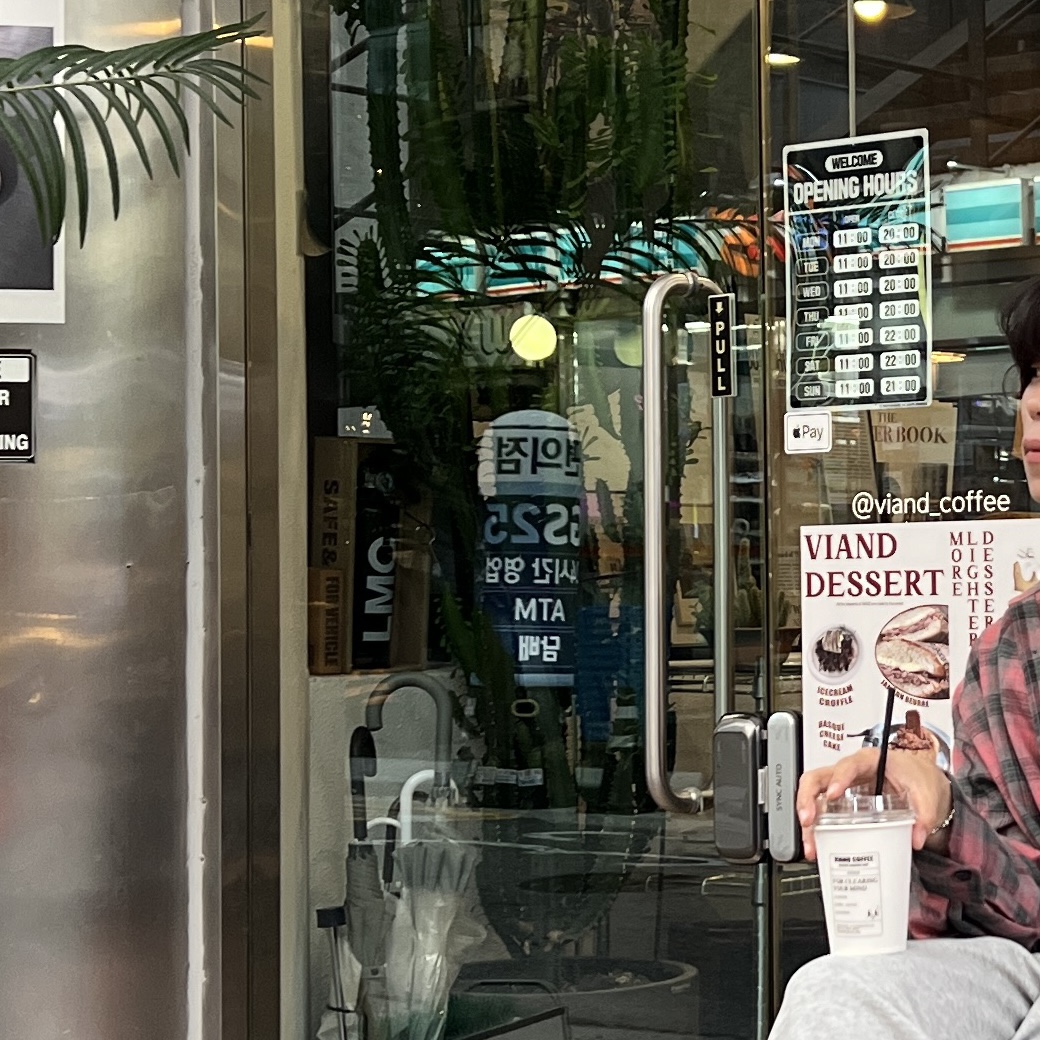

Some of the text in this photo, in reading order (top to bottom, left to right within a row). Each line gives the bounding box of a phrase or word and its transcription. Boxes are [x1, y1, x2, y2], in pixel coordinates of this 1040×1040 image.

[831, 152, 878, 170] WELCOME
[793, 170, 919, 205] OPENING HOURS
[804, 261, 819, 273] TUE
[802, 286, 821, 298] WED
[804, 311, 820, 323] THU
[715, 321, 726, 391] PULL
[804, 360, 820, 372] SAT
[803, 385, 821, 397] SUN
[877, 411, 897, 424] THE
[802, 424, 824, 442] Pay
[873, 425, 948, 444] ER BOOK
[851, 489, 1011, 520] @viand_coffee
[804, 532, 898, 560] VIAND
[950, 531, 963, 597] MORE
[805, 569, 945, 598] DESSERT
[982, 531, 995, 625] DESSER
[967, 531, 979, 647] LIGHTER
[816, 684, 854, 697] ICECREAM
[822, 740, 842, 752] CAKE
[775, 763, 783, 787] AUTO
